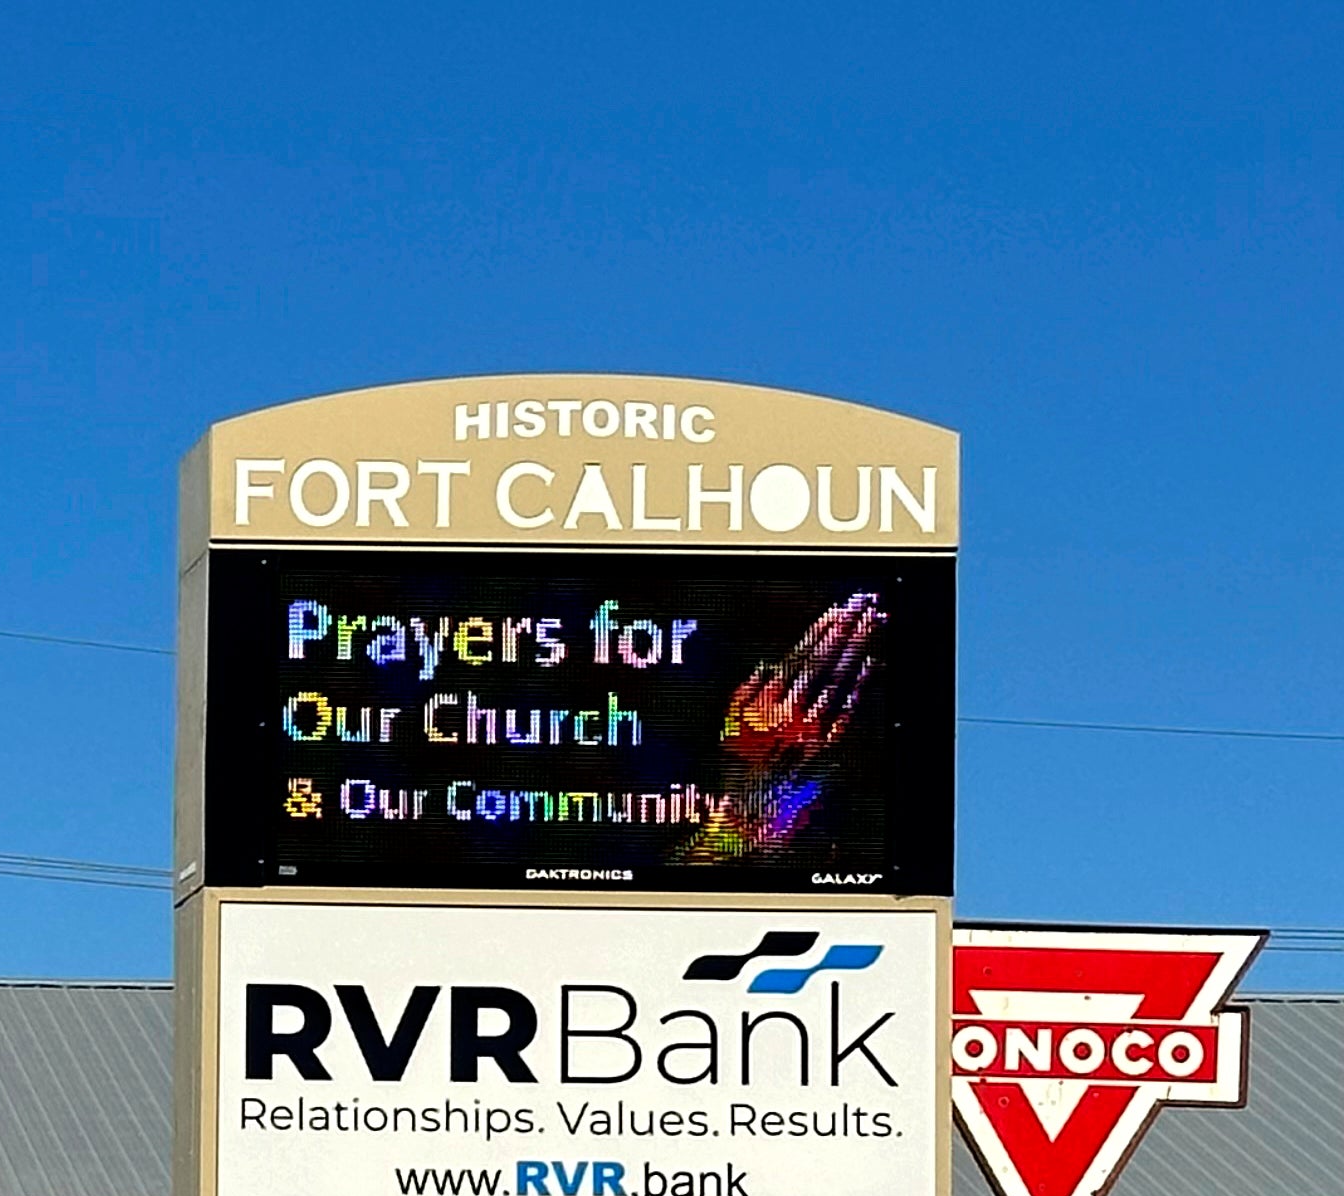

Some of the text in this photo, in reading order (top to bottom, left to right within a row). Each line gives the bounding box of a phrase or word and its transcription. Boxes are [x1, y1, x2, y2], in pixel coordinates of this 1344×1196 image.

[455, 400, 716, 443] HISTORIC
[234, 458, 938, 533] FORT CALHOUN
[287, 599, 698, 681] Prayers for
[282, 690, 642, 747] Our Church
[283, 777, 730, 826] & Our Community
[525, 868, 634, 882] DAKTRONICS
[952, 1025, 1205, 1077] ONOCO
[241, 1096, 904, 1142] Relationships. Values. Results.
